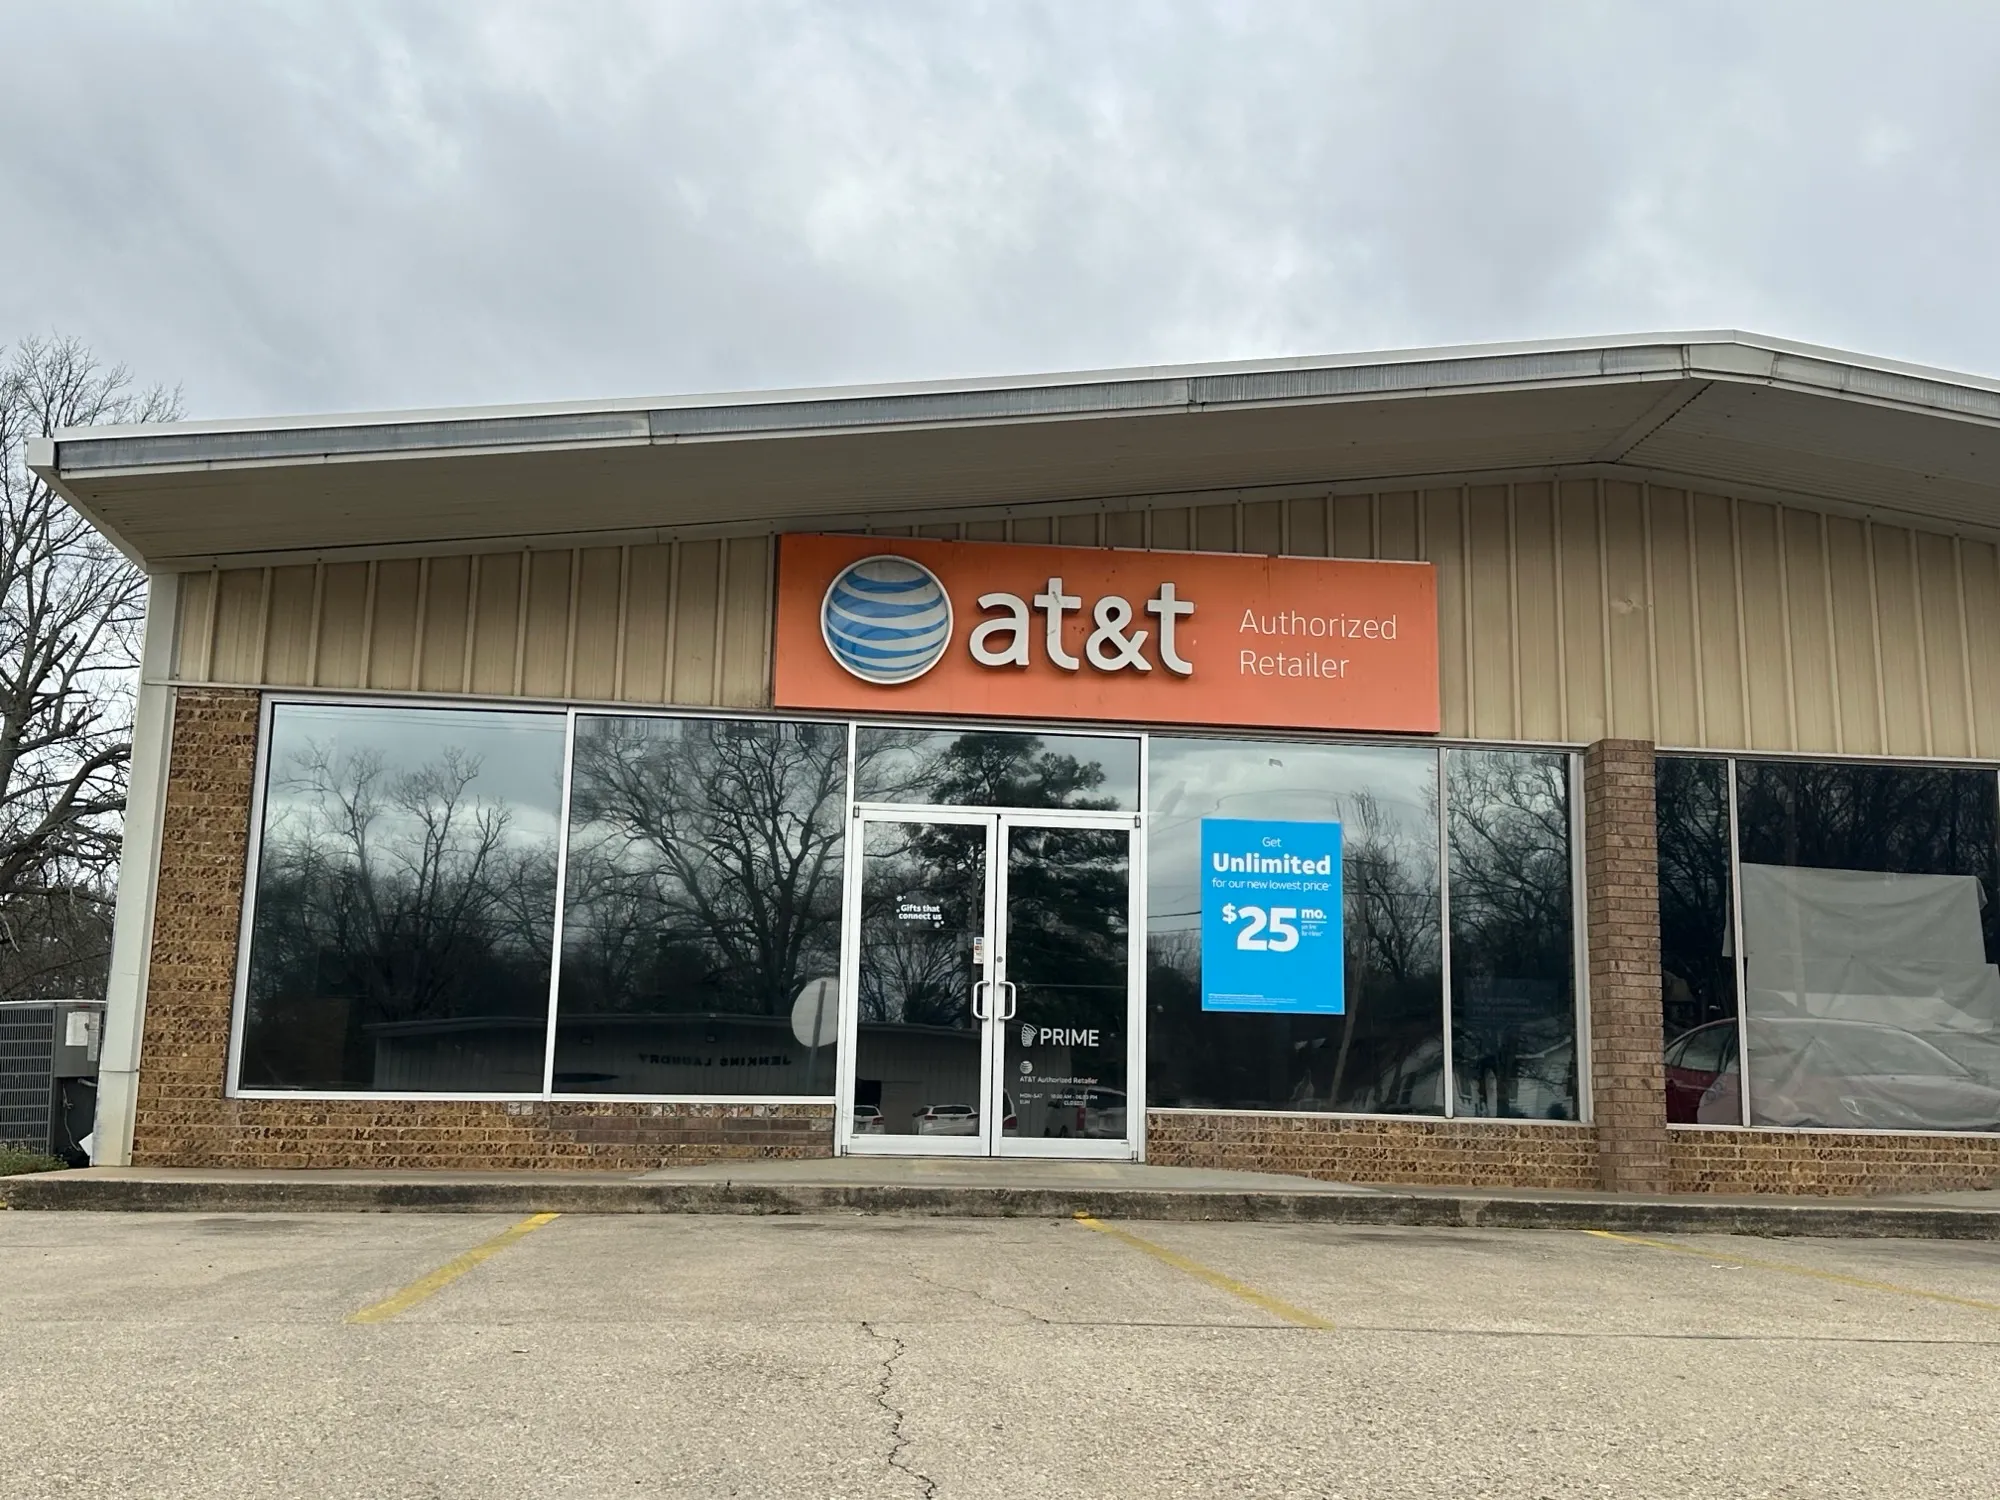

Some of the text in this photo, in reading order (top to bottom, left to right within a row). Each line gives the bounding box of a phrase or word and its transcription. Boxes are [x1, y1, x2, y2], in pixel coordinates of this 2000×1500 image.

[968, 577, 1195, 676] at&t
[1239, 608, 1397, 640] Authorized
[1240, 650, 1350, 678] Retailer
[1262, 836, 1282, 848] Get
[1212, 852, 1331, 875] Unlimited
[1212, 877, 1226, 888] for
[1228, 880, 1245, 889] our
[1246, 880, 1268, 889] new
[1269, 880, 1301, 890] lowest
[900, 904, 940, 912] Gifts that
[1301, 908, 1327, 919] mo.
[1040, 1028, 1100, 1047] PRIME
